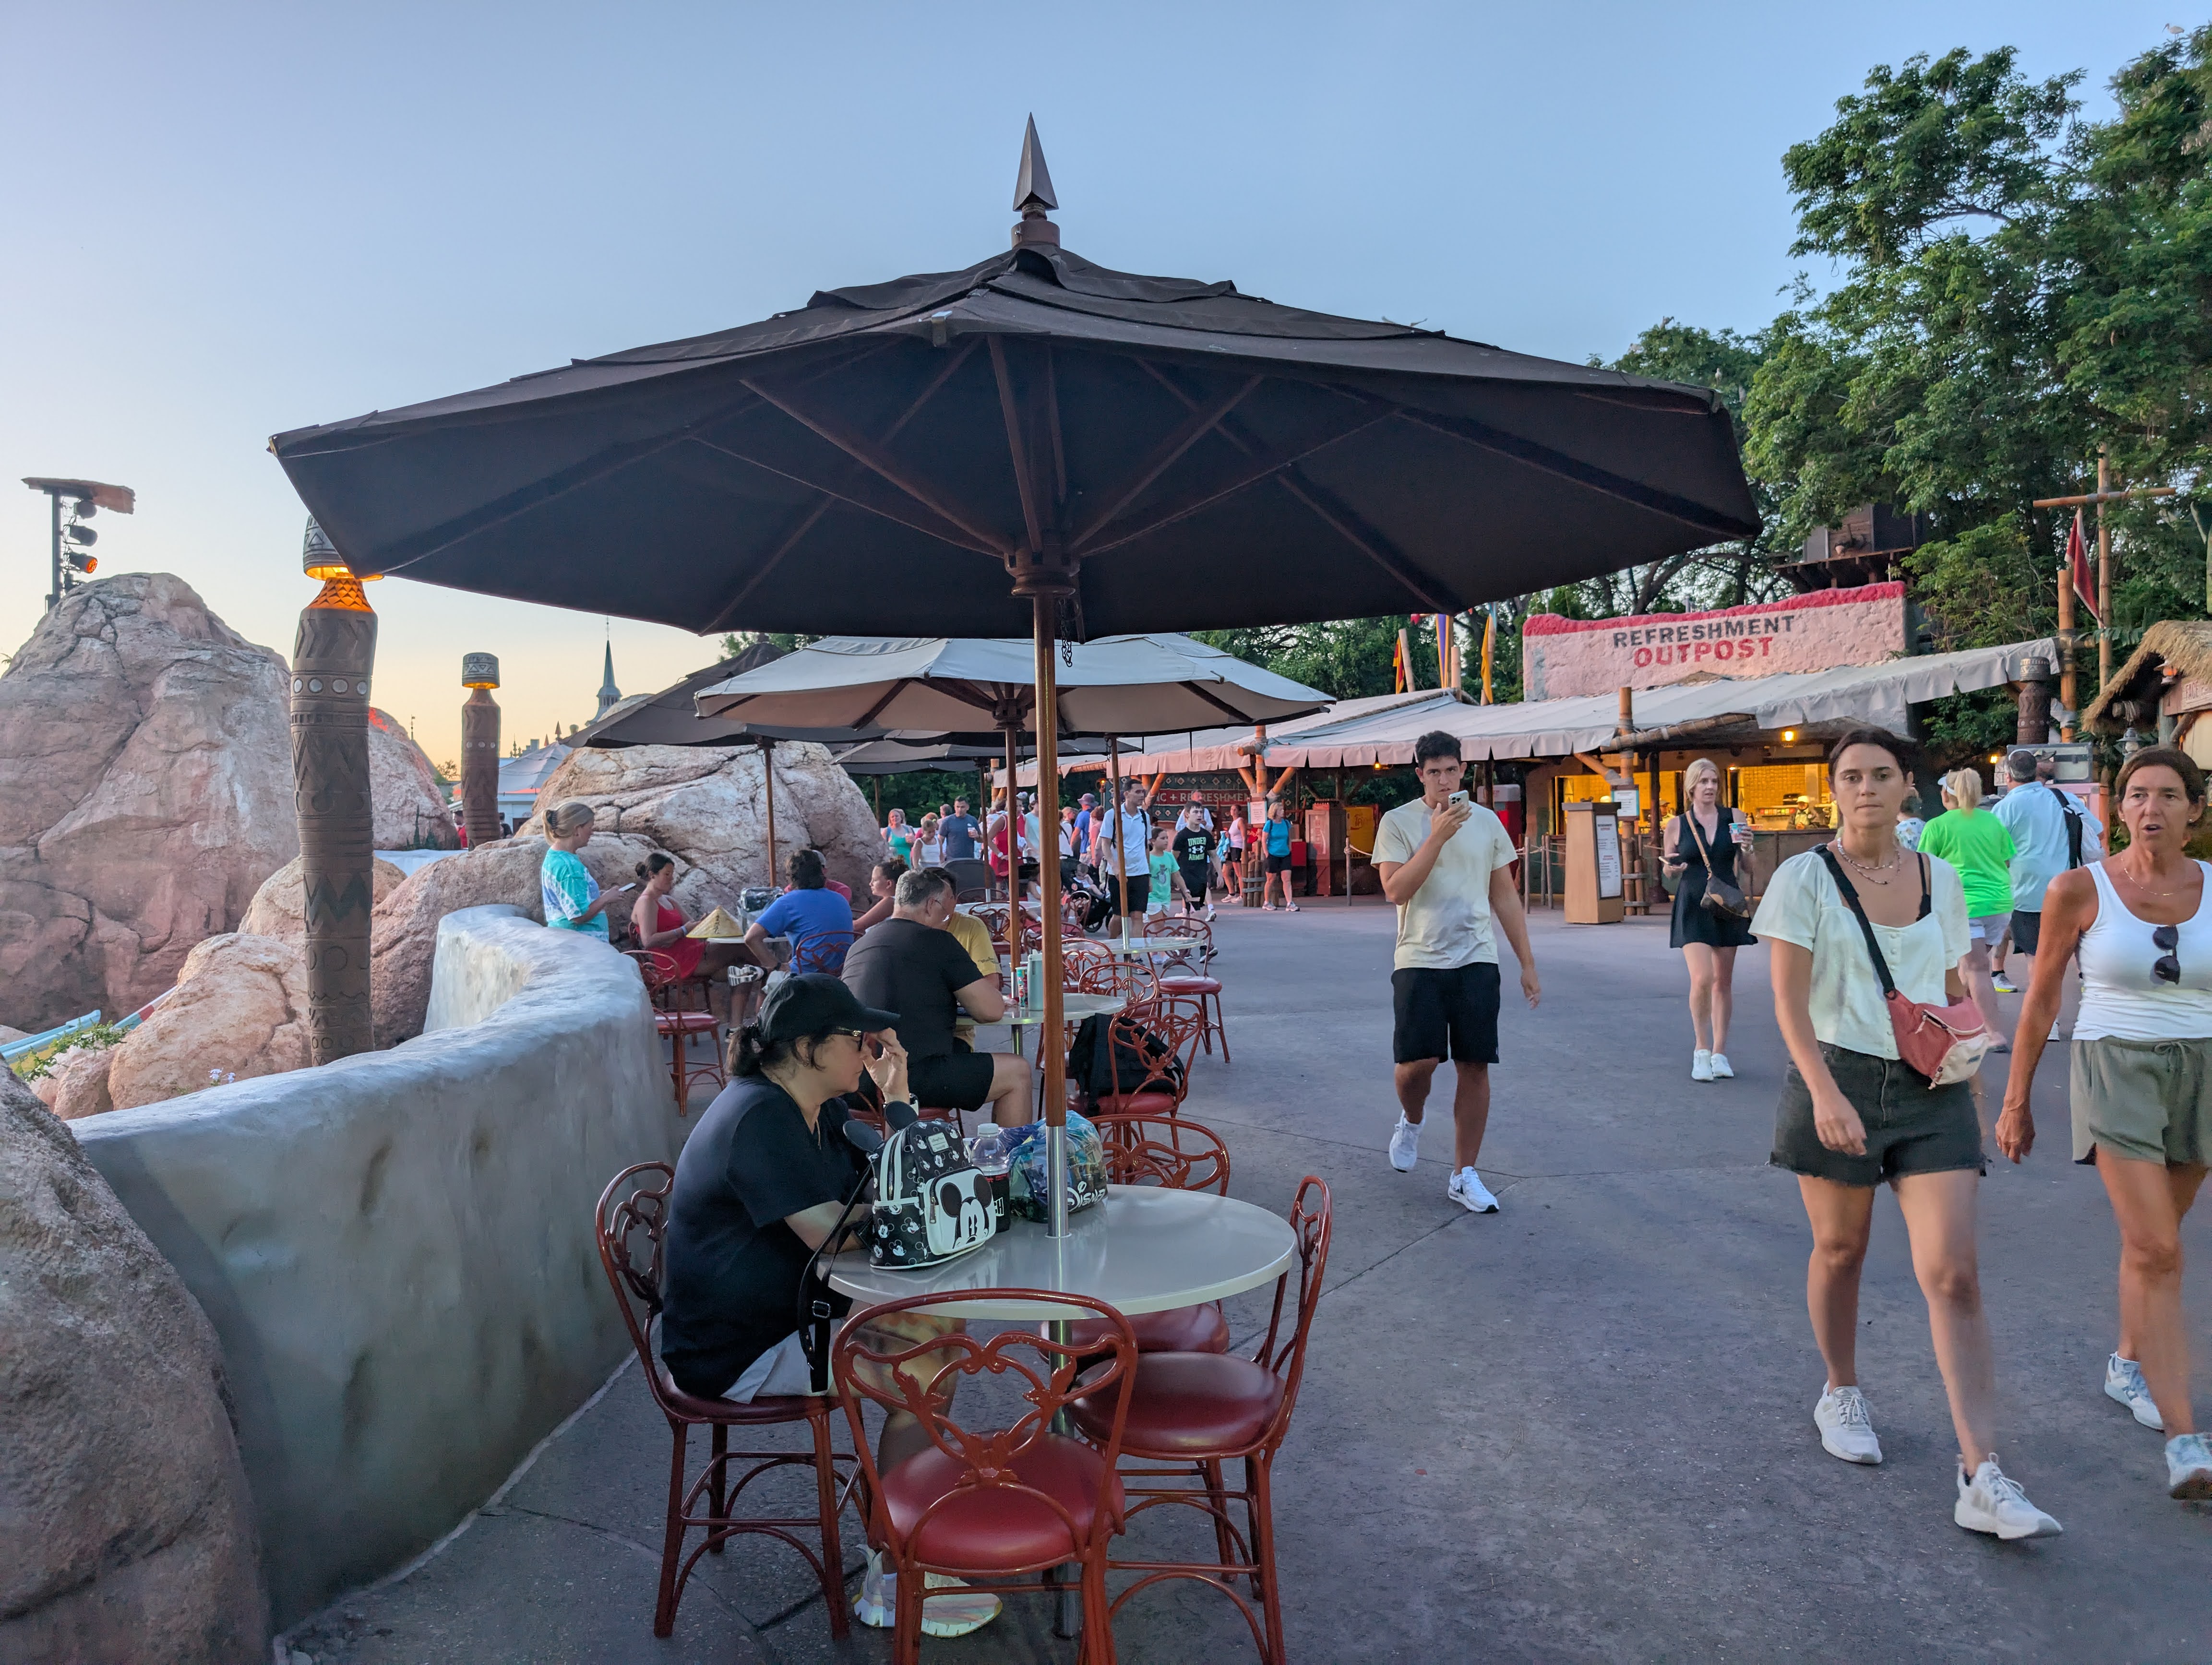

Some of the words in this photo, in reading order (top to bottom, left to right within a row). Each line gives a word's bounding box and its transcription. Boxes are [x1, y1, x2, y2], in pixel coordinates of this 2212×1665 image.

[1613, 615, 1795, 649] REFRESHMENT
[1634, 637, 1774, 667] OUTPOST
[1187, 837, 1207, 847] UNDER
